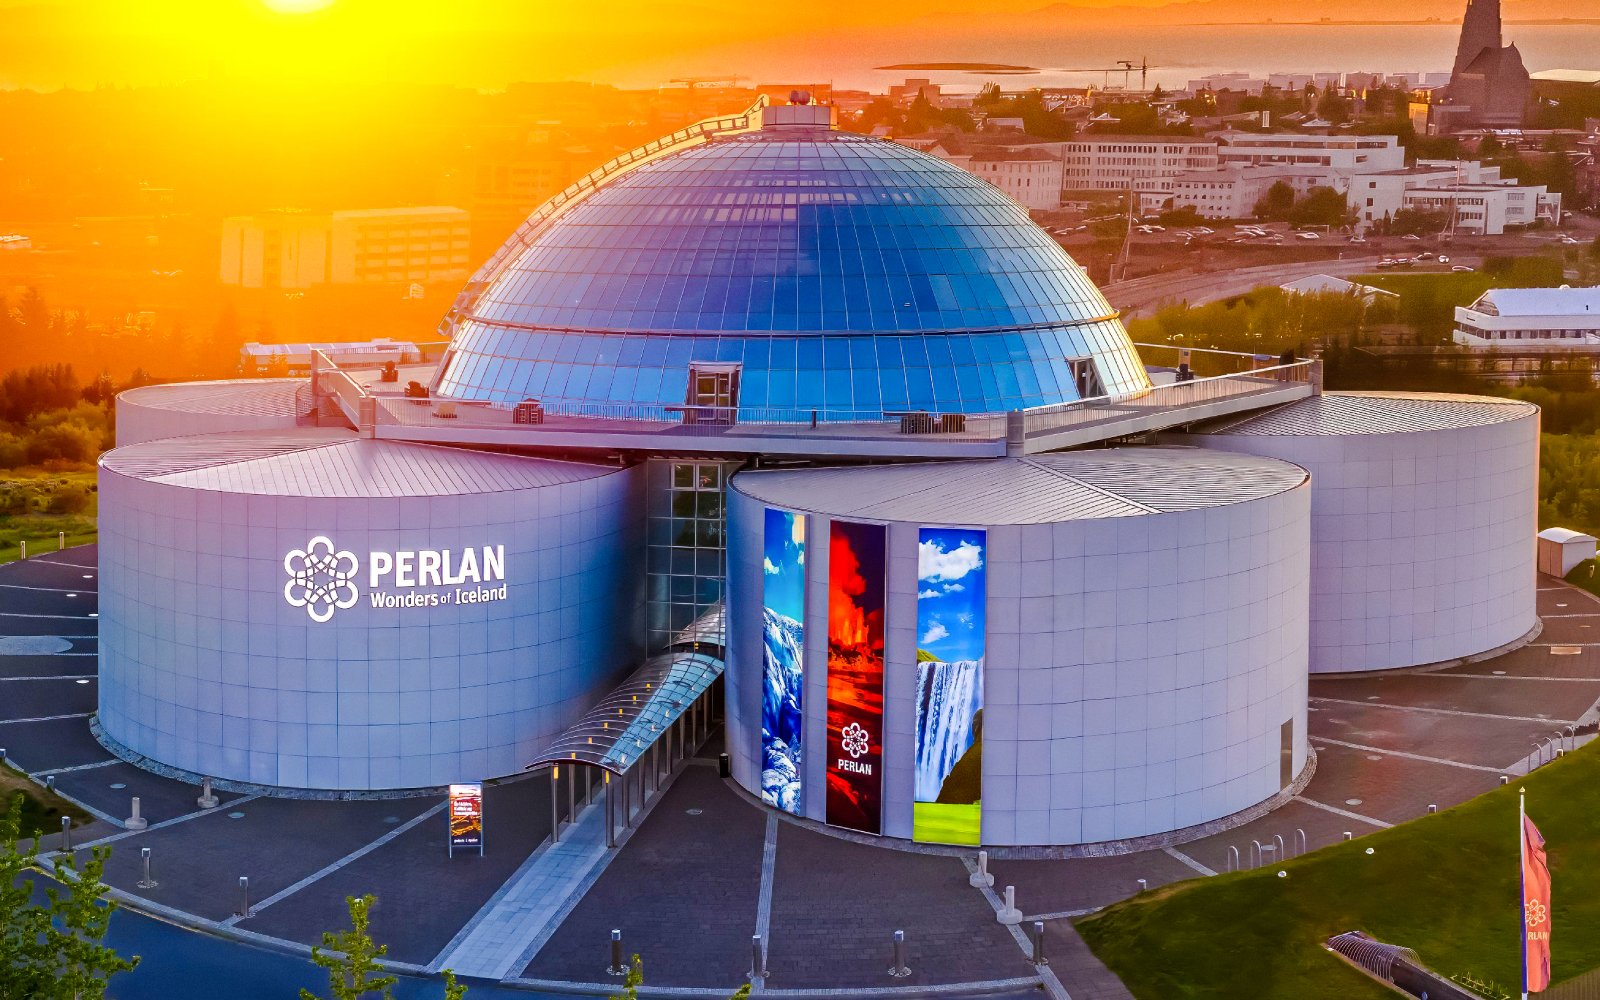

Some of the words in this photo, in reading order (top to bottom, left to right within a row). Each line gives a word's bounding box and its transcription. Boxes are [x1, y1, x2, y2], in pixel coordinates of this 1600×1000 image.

[369, 544, 505, 588] PERLAN
[370, 590, 439, 608] Wonders
[440, 592, 451, 604] of
[455, 583, 507, 605] Iceland
[837, 758, 872, 776] PERLAN
[1527, 931, 1548, 941] RLAN
